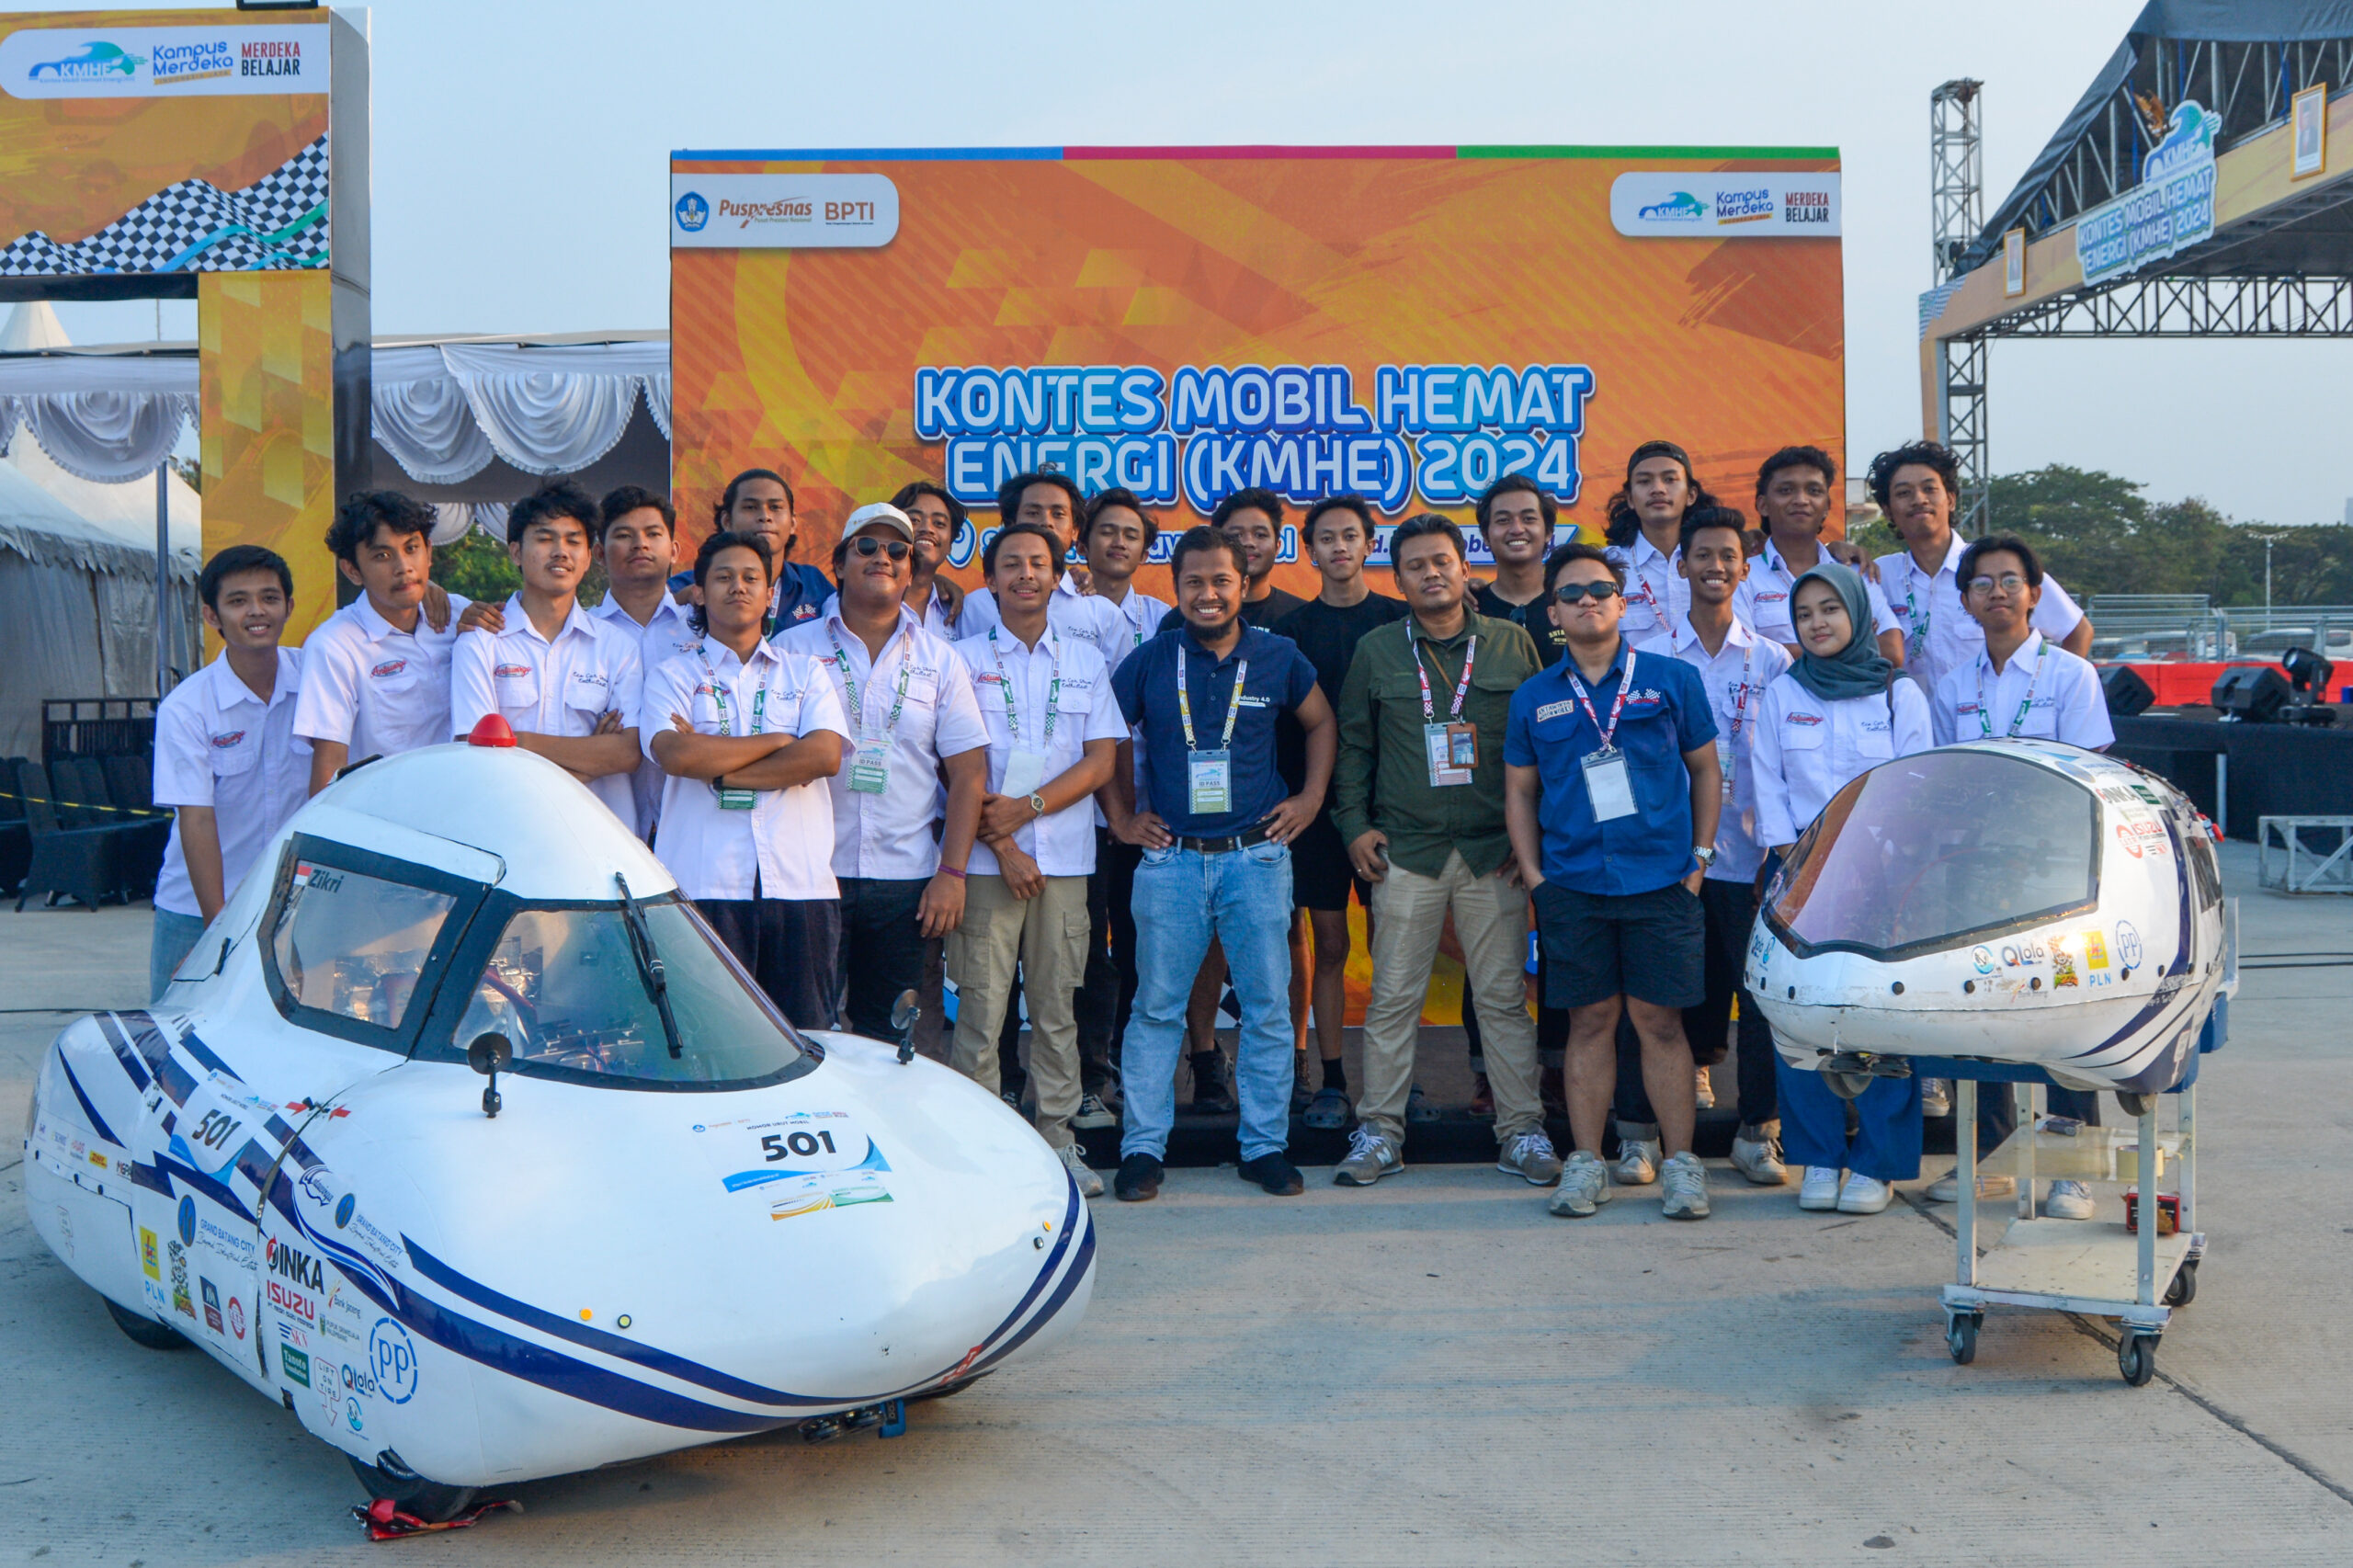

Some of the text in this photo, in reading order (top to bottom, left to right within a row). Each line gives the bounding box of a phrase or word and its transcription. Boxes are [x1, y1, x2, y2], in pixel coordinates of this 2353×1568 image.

[153, 41, 227, 61] Kampus
[242, 41, 301, 58] MERDEKA
[61, 62, 111, 77] KMHE
[153, 55, 233, 76] Merdeka
[242, 59, 301, 76] BELAJAR
[2163, 139, 2196, 169] KMHE
[1717, 189, 1769, 206] Kampus
[1717, 200, 1774, 219] Merdeka
[1786, 192, 1829, 207] MERDEKA
[2080, 168, 2212, 248] KONTES MOBIL HEMAT
[719, 198, 874, 228] Puspresnas BPTI
[1657, 207, 1689, 218] KMHE
[1786, 207, 1829, 222] BELAJAR
[2086, 199, 2210, 272] ENERGI (KMHE) 2024
[921, 372, 1587, 429] KONTES MOBIL HEMAT
[950, 434, 1573, 508] ENERGI (KMHE) 2024
[2131, 820, 2163, 835] ISUZU
[308, 869, 345, 893] Zikri
[2089, 973, 2111, 987] PLN
[192, 1108, 242, 1151] 501
[761, 1130, 836, 1162] 501
[200, 1219, 256, 1254] GRAND BATANG CITY
[279, 1243, 324, 1296] INKA
[144, 1279, 165, 1305] PLN
[267, 1278, 314, 1321] ISUZU
[284, 1349, 307, 1370] Tanoto
[378, 1336, 409, 1384] PP
